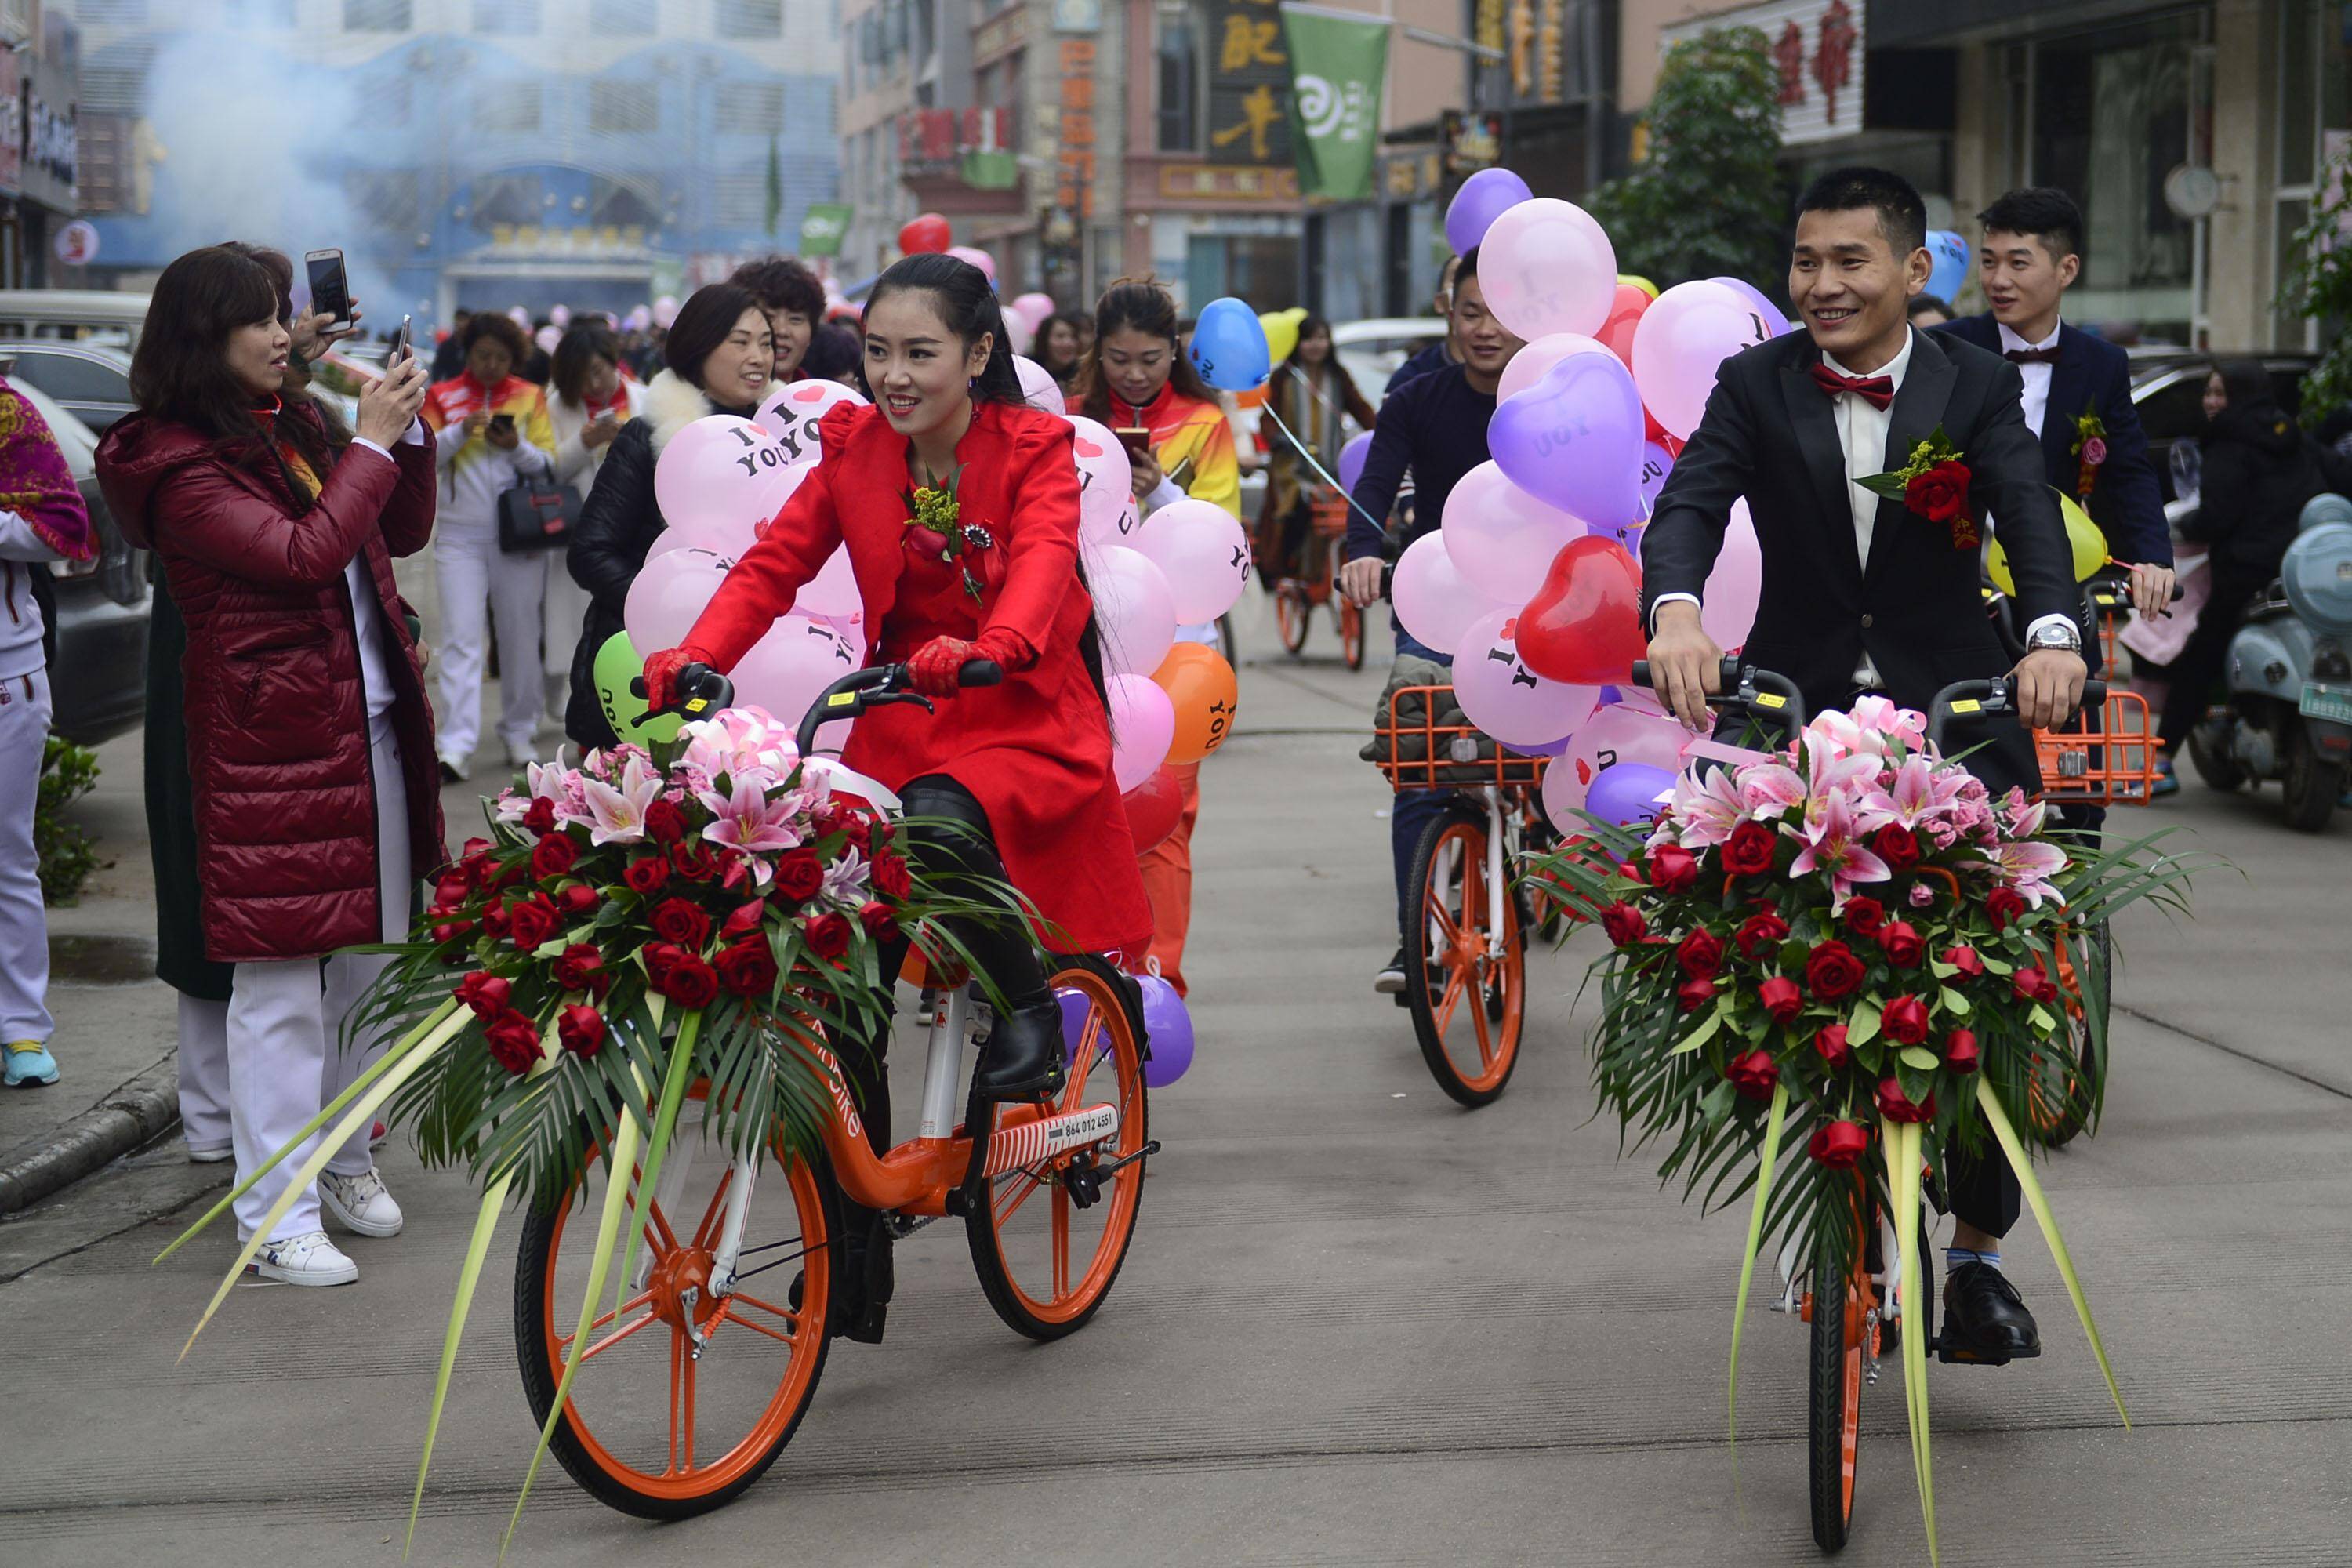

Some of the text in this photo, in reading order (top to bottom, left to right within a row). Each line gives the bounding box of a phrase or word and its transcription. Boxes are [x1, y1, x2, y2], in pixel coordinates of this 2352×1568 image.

[771, 402, 798, 425] I
[728, 427, 754, 446] I
[808, 626, 833, 641] I
[1488, 648, 1515, 666] I
[1205, 699, 1225, 750] YOU
[1066, 1123, 1080, 1137] 864
[1082, 1118, 1096, 1133] 012
[1098, 1113, 1112, 1128] 4551
